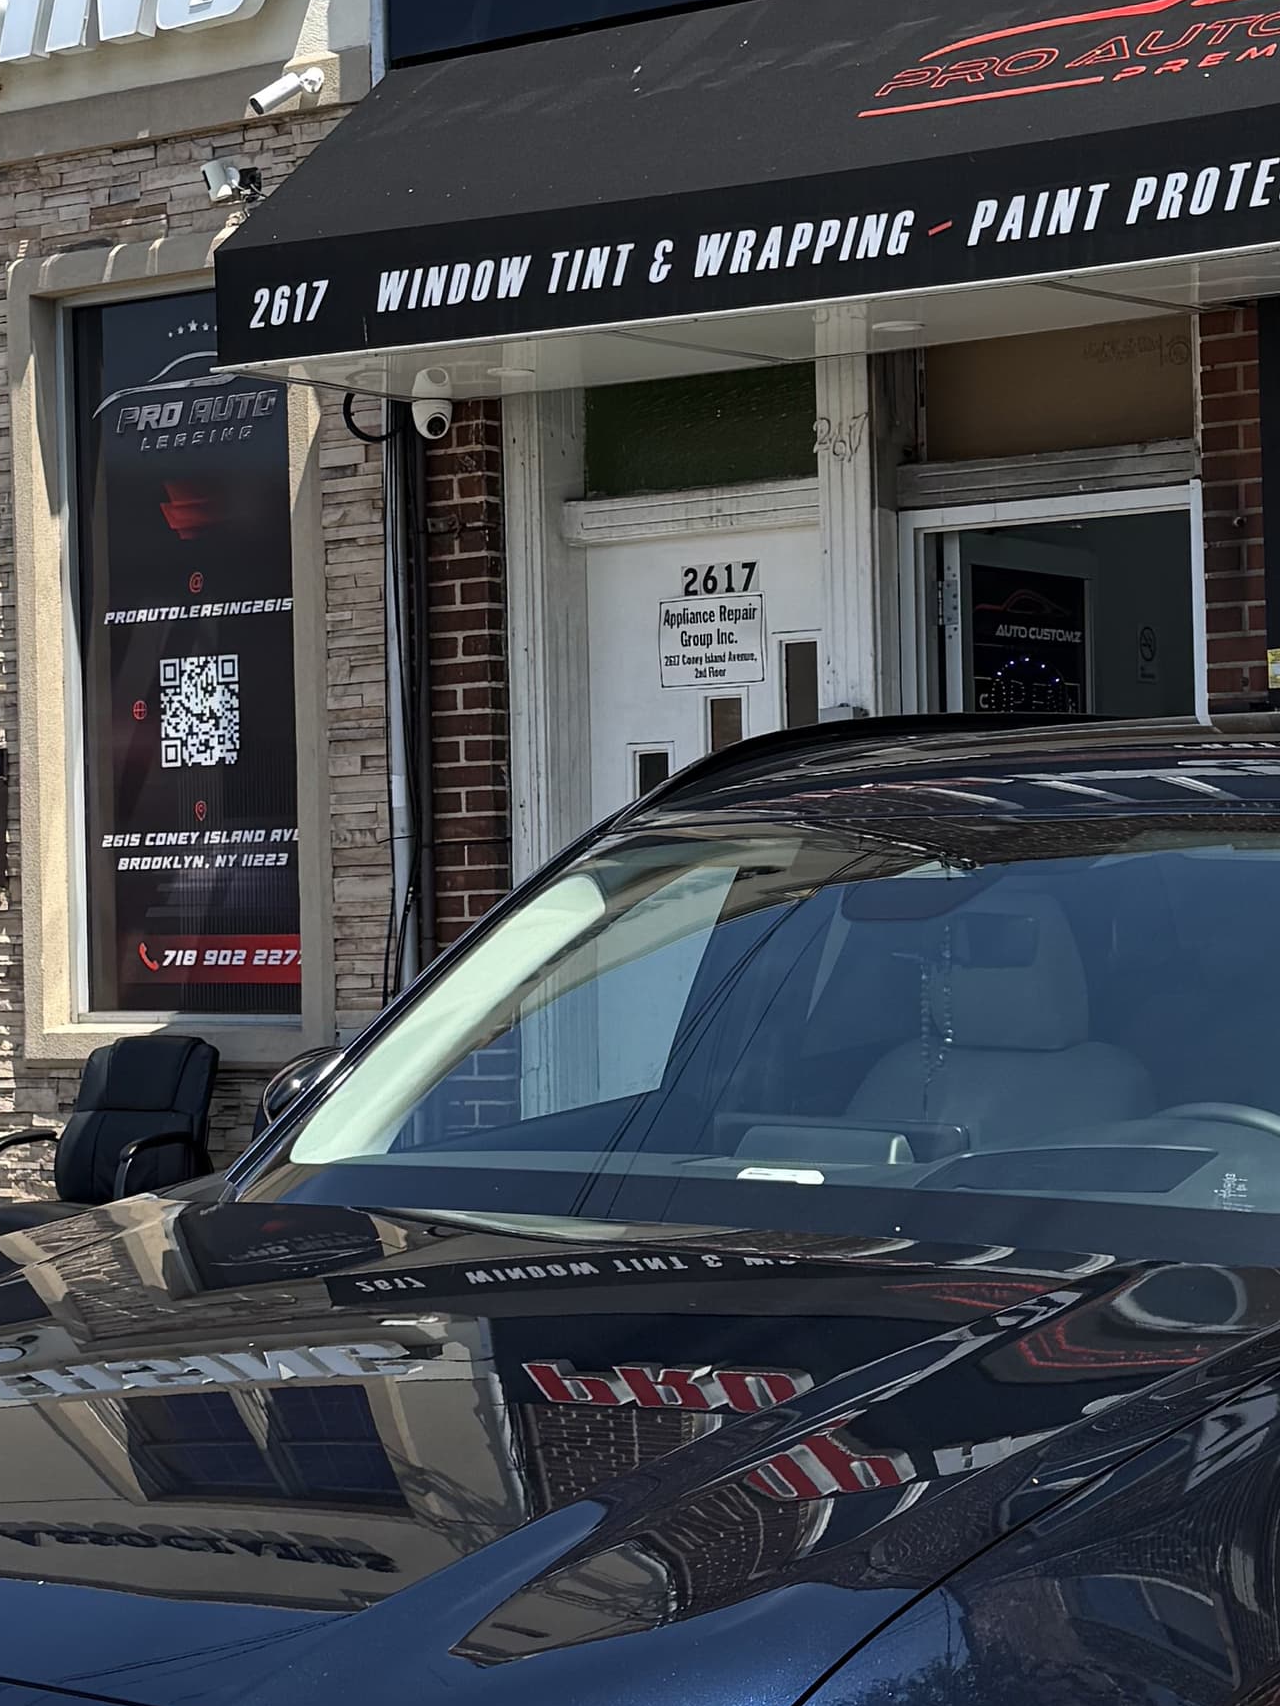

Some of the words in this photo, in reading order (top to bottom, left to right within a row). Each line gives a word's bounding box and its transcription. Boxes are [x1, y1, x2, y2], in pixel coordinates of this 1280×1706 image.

[874, 46, 1059, 98] PRO
[249, 279, 329, 330] 2617
[375, 254, 532, 314] WINDOW
[547, 239, 636, 294] TINT
[648, 239, 675, 282] &
[693, 208, 916, 278] WRAPPING
[966, 182, 1111, 247] PAINT
[116, 400, 184, 434] PRO
[187, 388, 279, 426] AUTO
[140, 424, 255, 452] LEASING
[187, 572, 205, 594] @
[683, 561, 758, 597] 2617
[103, 597, 294, 626] PROAUTOLEASING2615
[663, 608, 716, 630] Appliance
[719, 602, 758, 625] Repair
[680, 629, 714, 649] Group
[717, 627, 738, 646] Inc.
[995, 624, 1028, 639] AUTO
[1028, 627, 1082, 643] CUSTOMZ
[101, 833, 142, 849] 2615
[144, 830, 200, 847] CONEY
[203, 828, 267, 846] ISLAND
[117, 853, 211, 872] BROOKLYN,
[214, 852, 239, 869] NY
[240, 851, 290, 868] 11223
[162, 949, 197, 967] 718
[202, 948, 247, 967] 902
